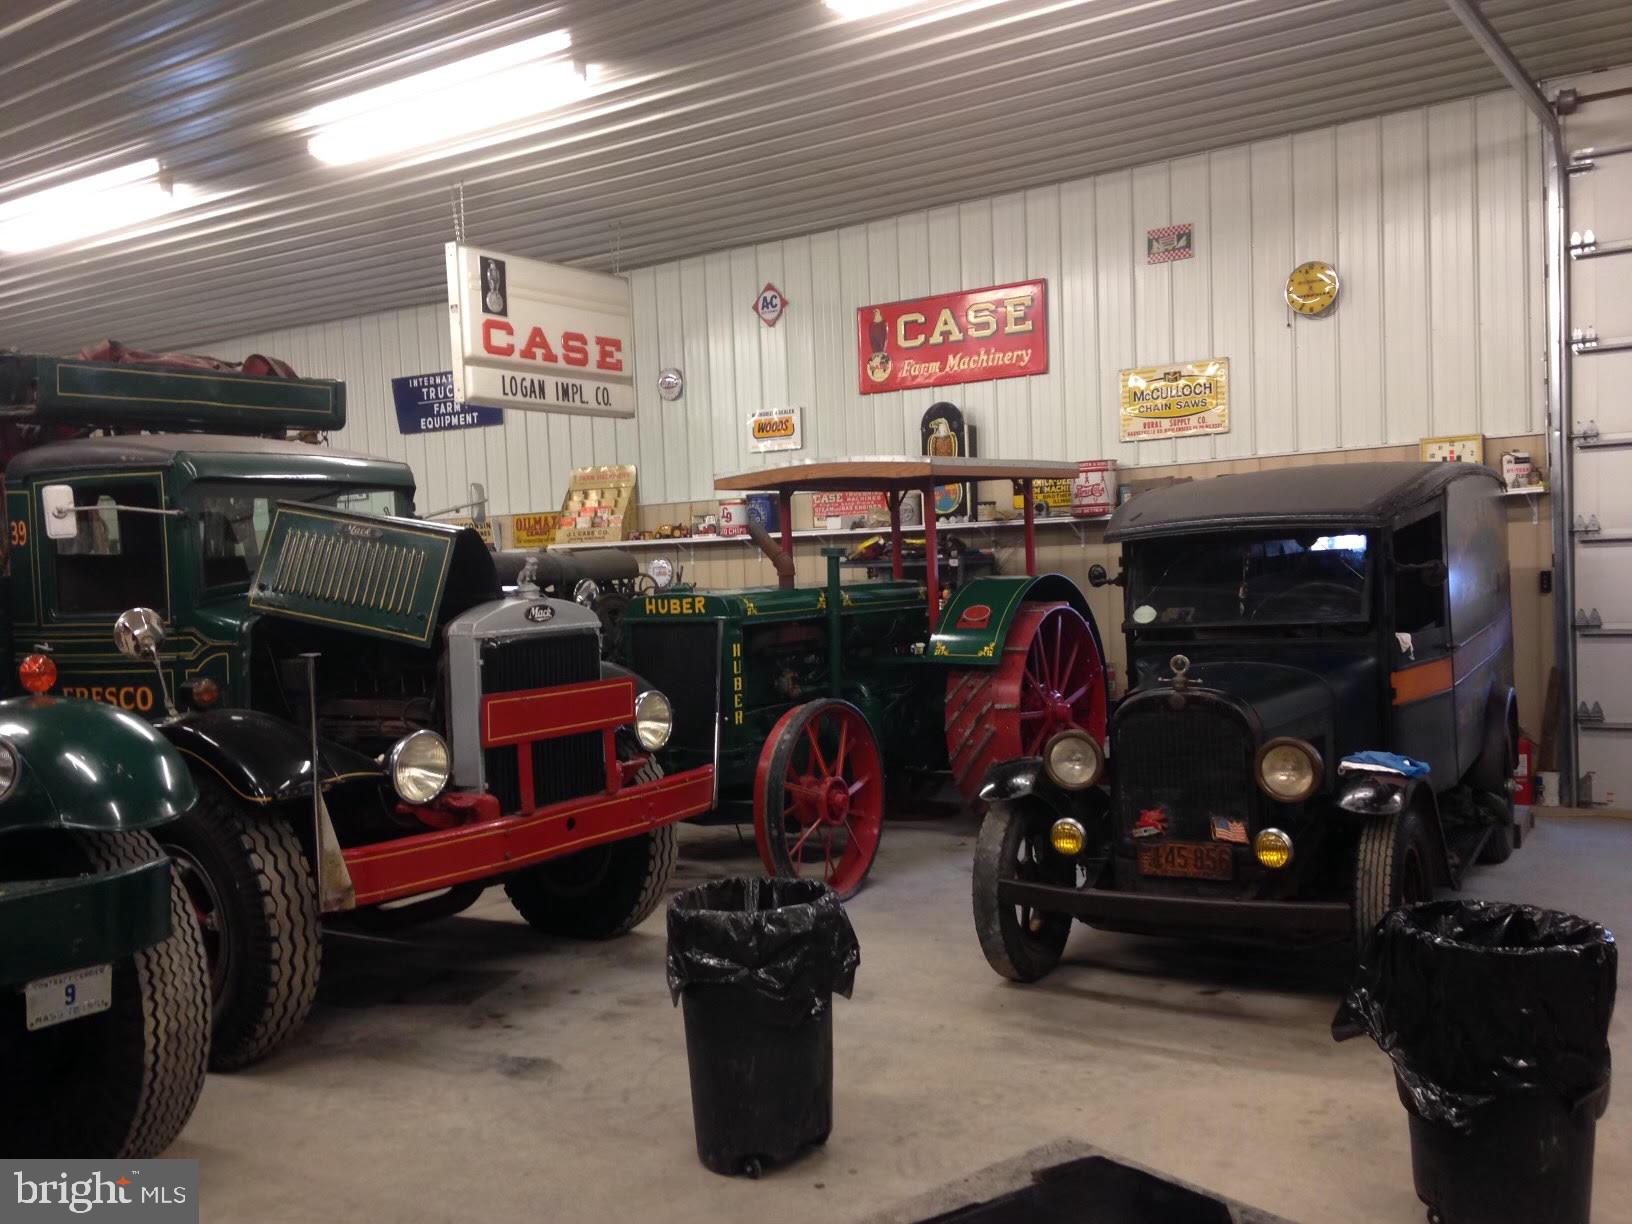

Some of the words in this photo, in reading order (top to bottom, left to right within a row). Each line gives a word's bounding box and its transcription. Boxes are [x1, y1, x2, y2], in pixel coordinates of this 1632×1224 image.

[896, 295, 1034, 349] CASE
[482, 318, 624, 372] CASE
[900, 360, 941, 377] Farm
[944, 349, 1032, 375] Machinery
[409, 375, 453, 388] INTERNAT
[502, 374, 546, 400] LOGAN
[555, 382, 589, 405] IMPL.
[595, 389, 612, 406] CO.
[421, 387, 454, 400] TRUC
[1133, 383, 1212, 402] McCULLOCH
[433, 403, 461, 414] FARM
[1138, 402, 1171, 413] CHAIN
[1176, 399, 1207, 409] SAWS
[420, 412, 479, 430] EQUIPMENT
[757, 419, 789, 433] WOODS
[1169, 417, 1191, 427] SUPPLY
[814, 492, 843, 504] CASE
[10, 521, 27, 546] 39
[528, 606, 553, 619] Mack
[645, 596, 706, 614] HUBER
[732, 643, 743, 725] HUBER
[65, 983, 76, 1006] 9
